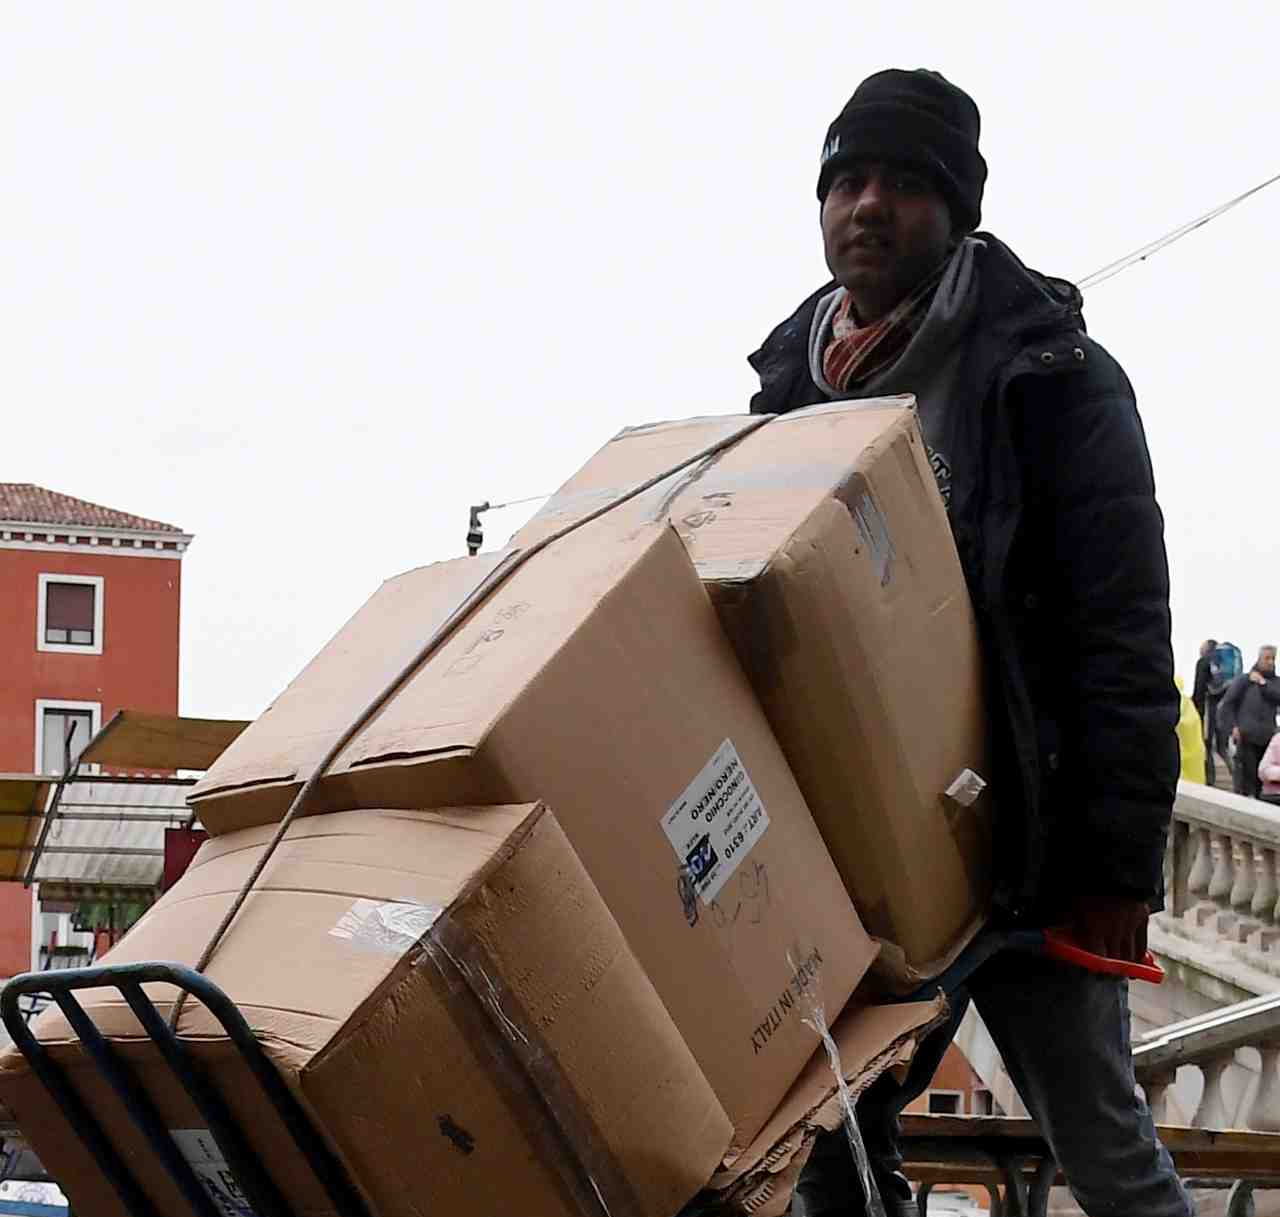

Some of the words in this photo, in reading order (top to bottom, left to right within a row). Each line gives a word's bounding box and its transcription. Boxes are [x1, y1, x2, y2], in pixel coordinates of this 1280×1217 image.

[703, 770, 745, 823] GINOCCHIO
[779, 989, 795, 1016] IN
[750, 1005, 783, 1055] ITALY
